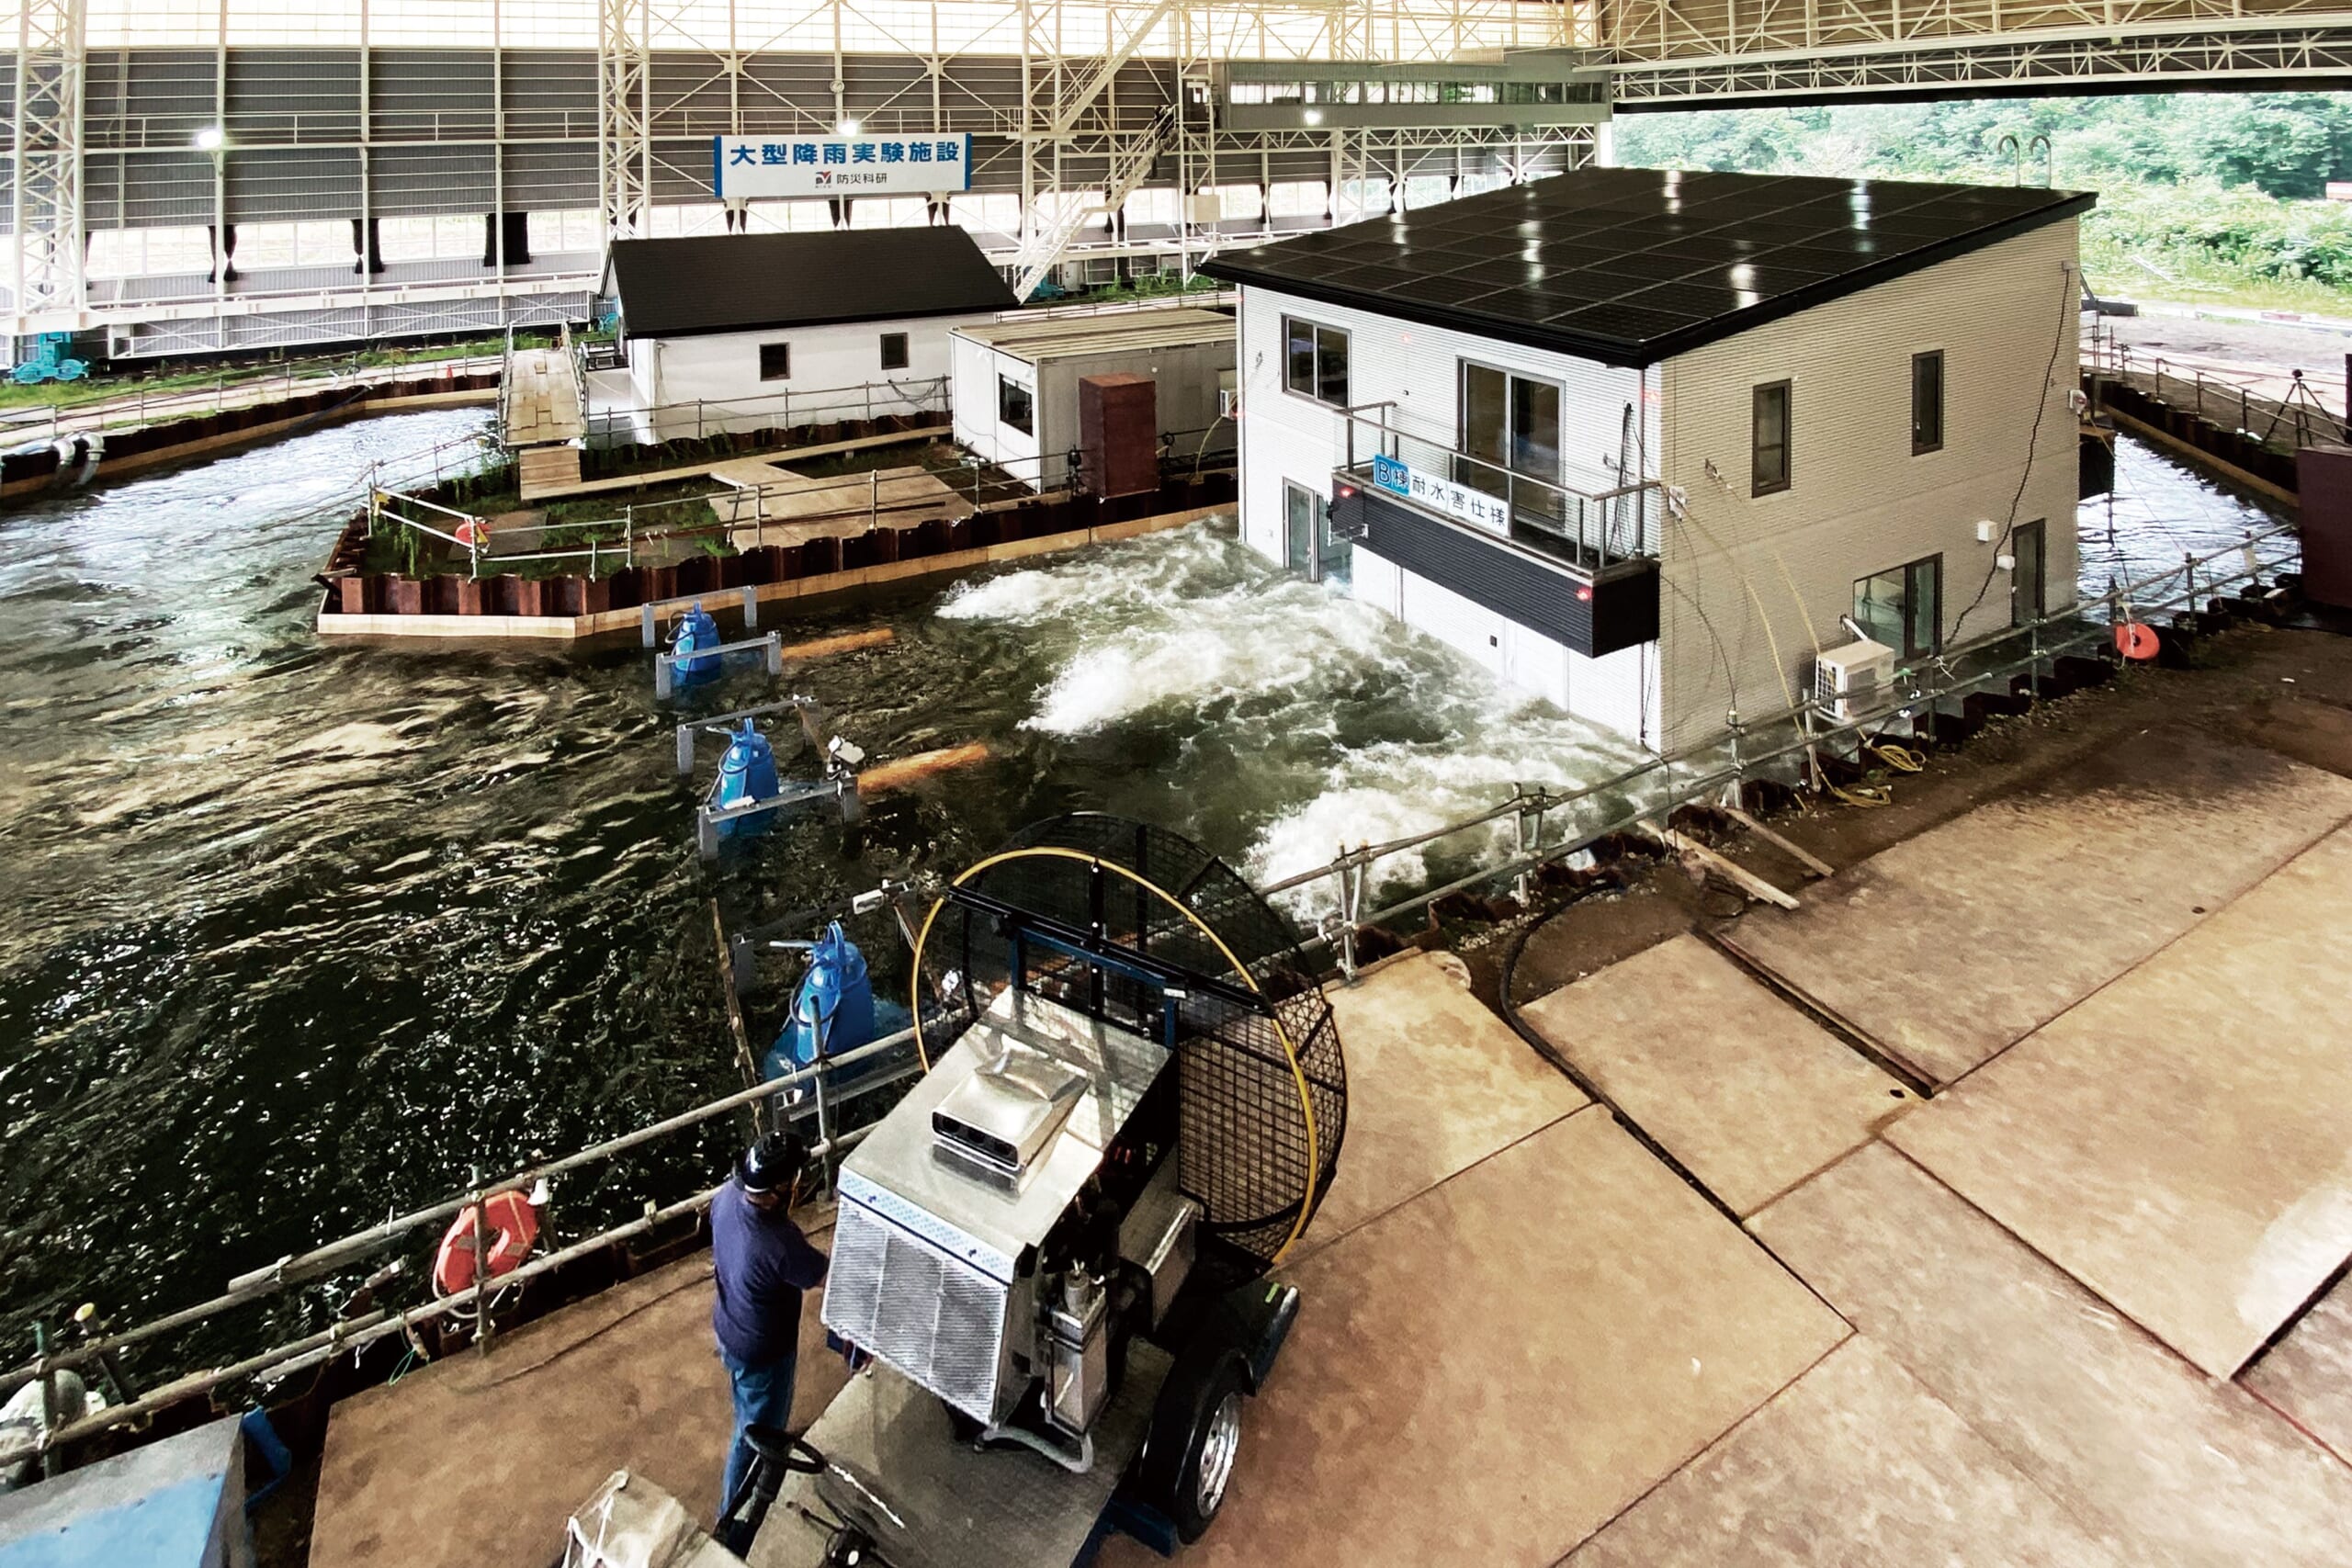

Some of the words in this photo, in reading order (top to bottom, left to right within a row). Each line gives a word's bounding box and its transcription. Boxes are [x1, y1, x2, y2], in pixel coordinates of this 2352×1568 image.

[729, 141, 960, 166] 大型降雨実験施設
[836, 173, 888, 185] 防災科研
[1378, 461, 1409, 489] B棟
[1411, 474, 1506, 526] 耐水害仕様
